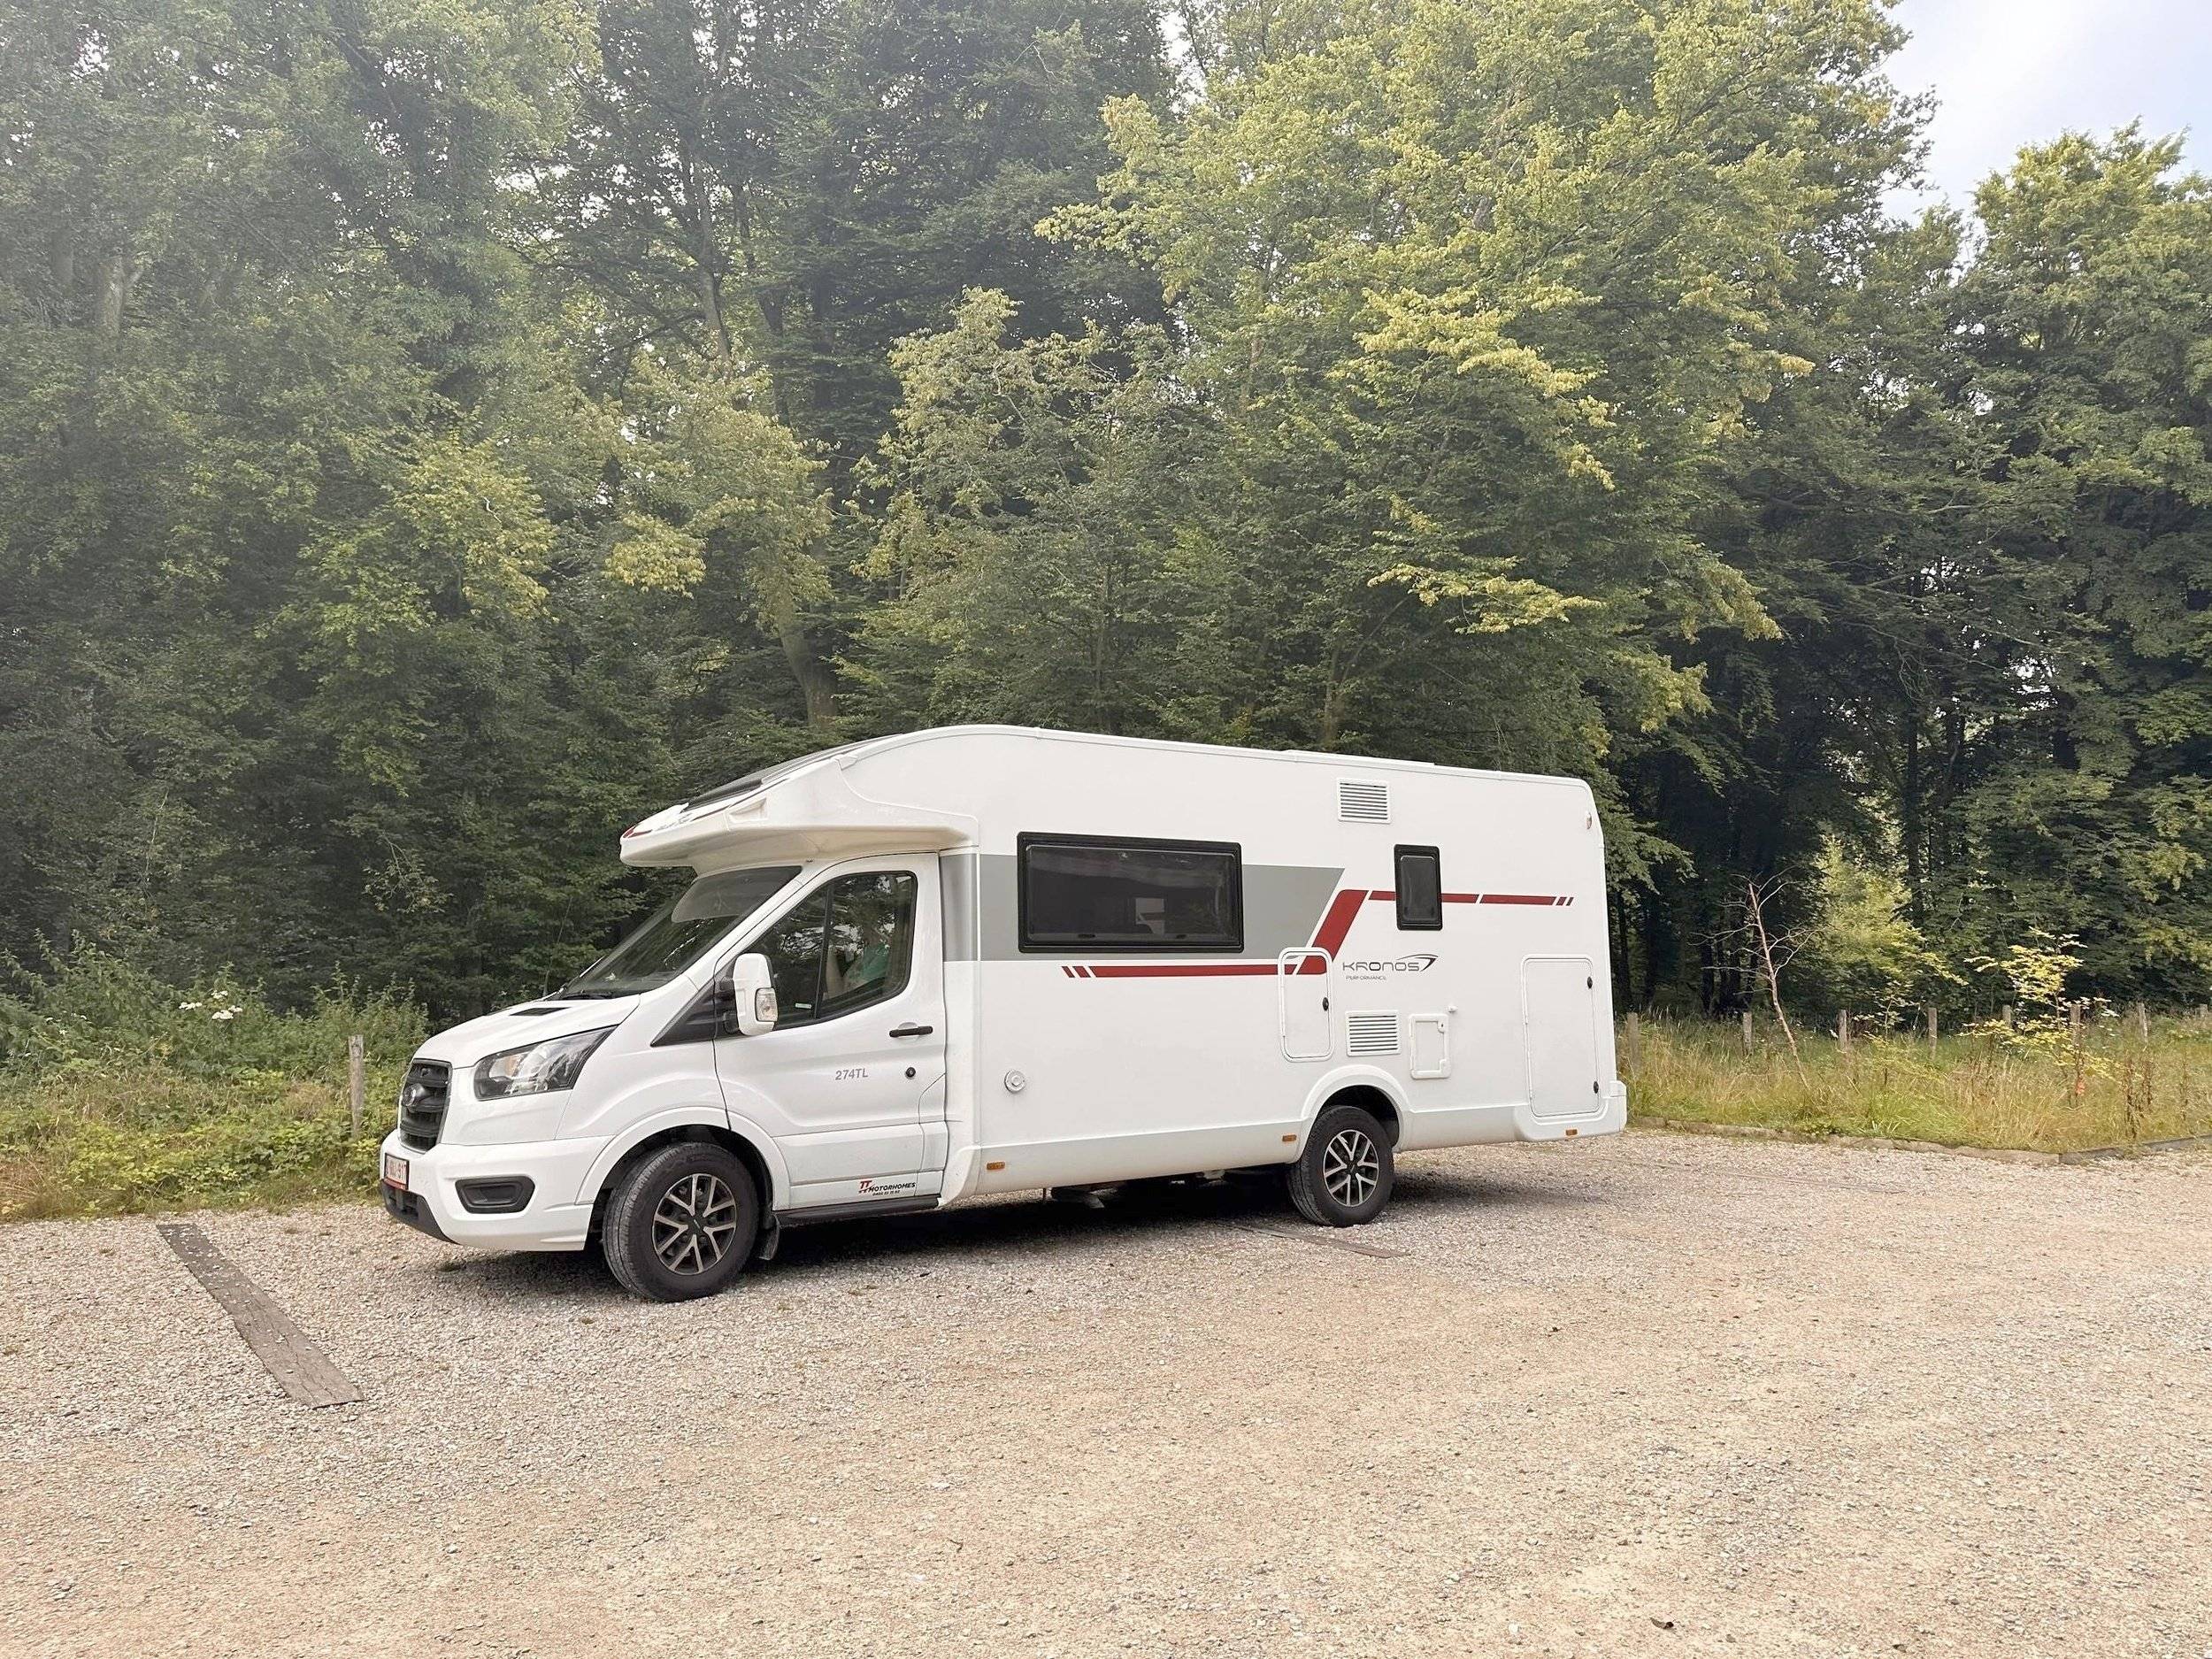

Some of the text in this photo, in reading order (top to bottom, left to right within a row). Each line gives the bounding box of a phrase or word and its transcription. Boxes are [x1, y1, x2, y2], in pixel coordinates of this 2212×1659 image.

[1342, 962, 1420, 972] KRONOS
[835, 1068, 869, 1080] 274TL
[868, 1182, 916, 1192] MOTORHOMES
